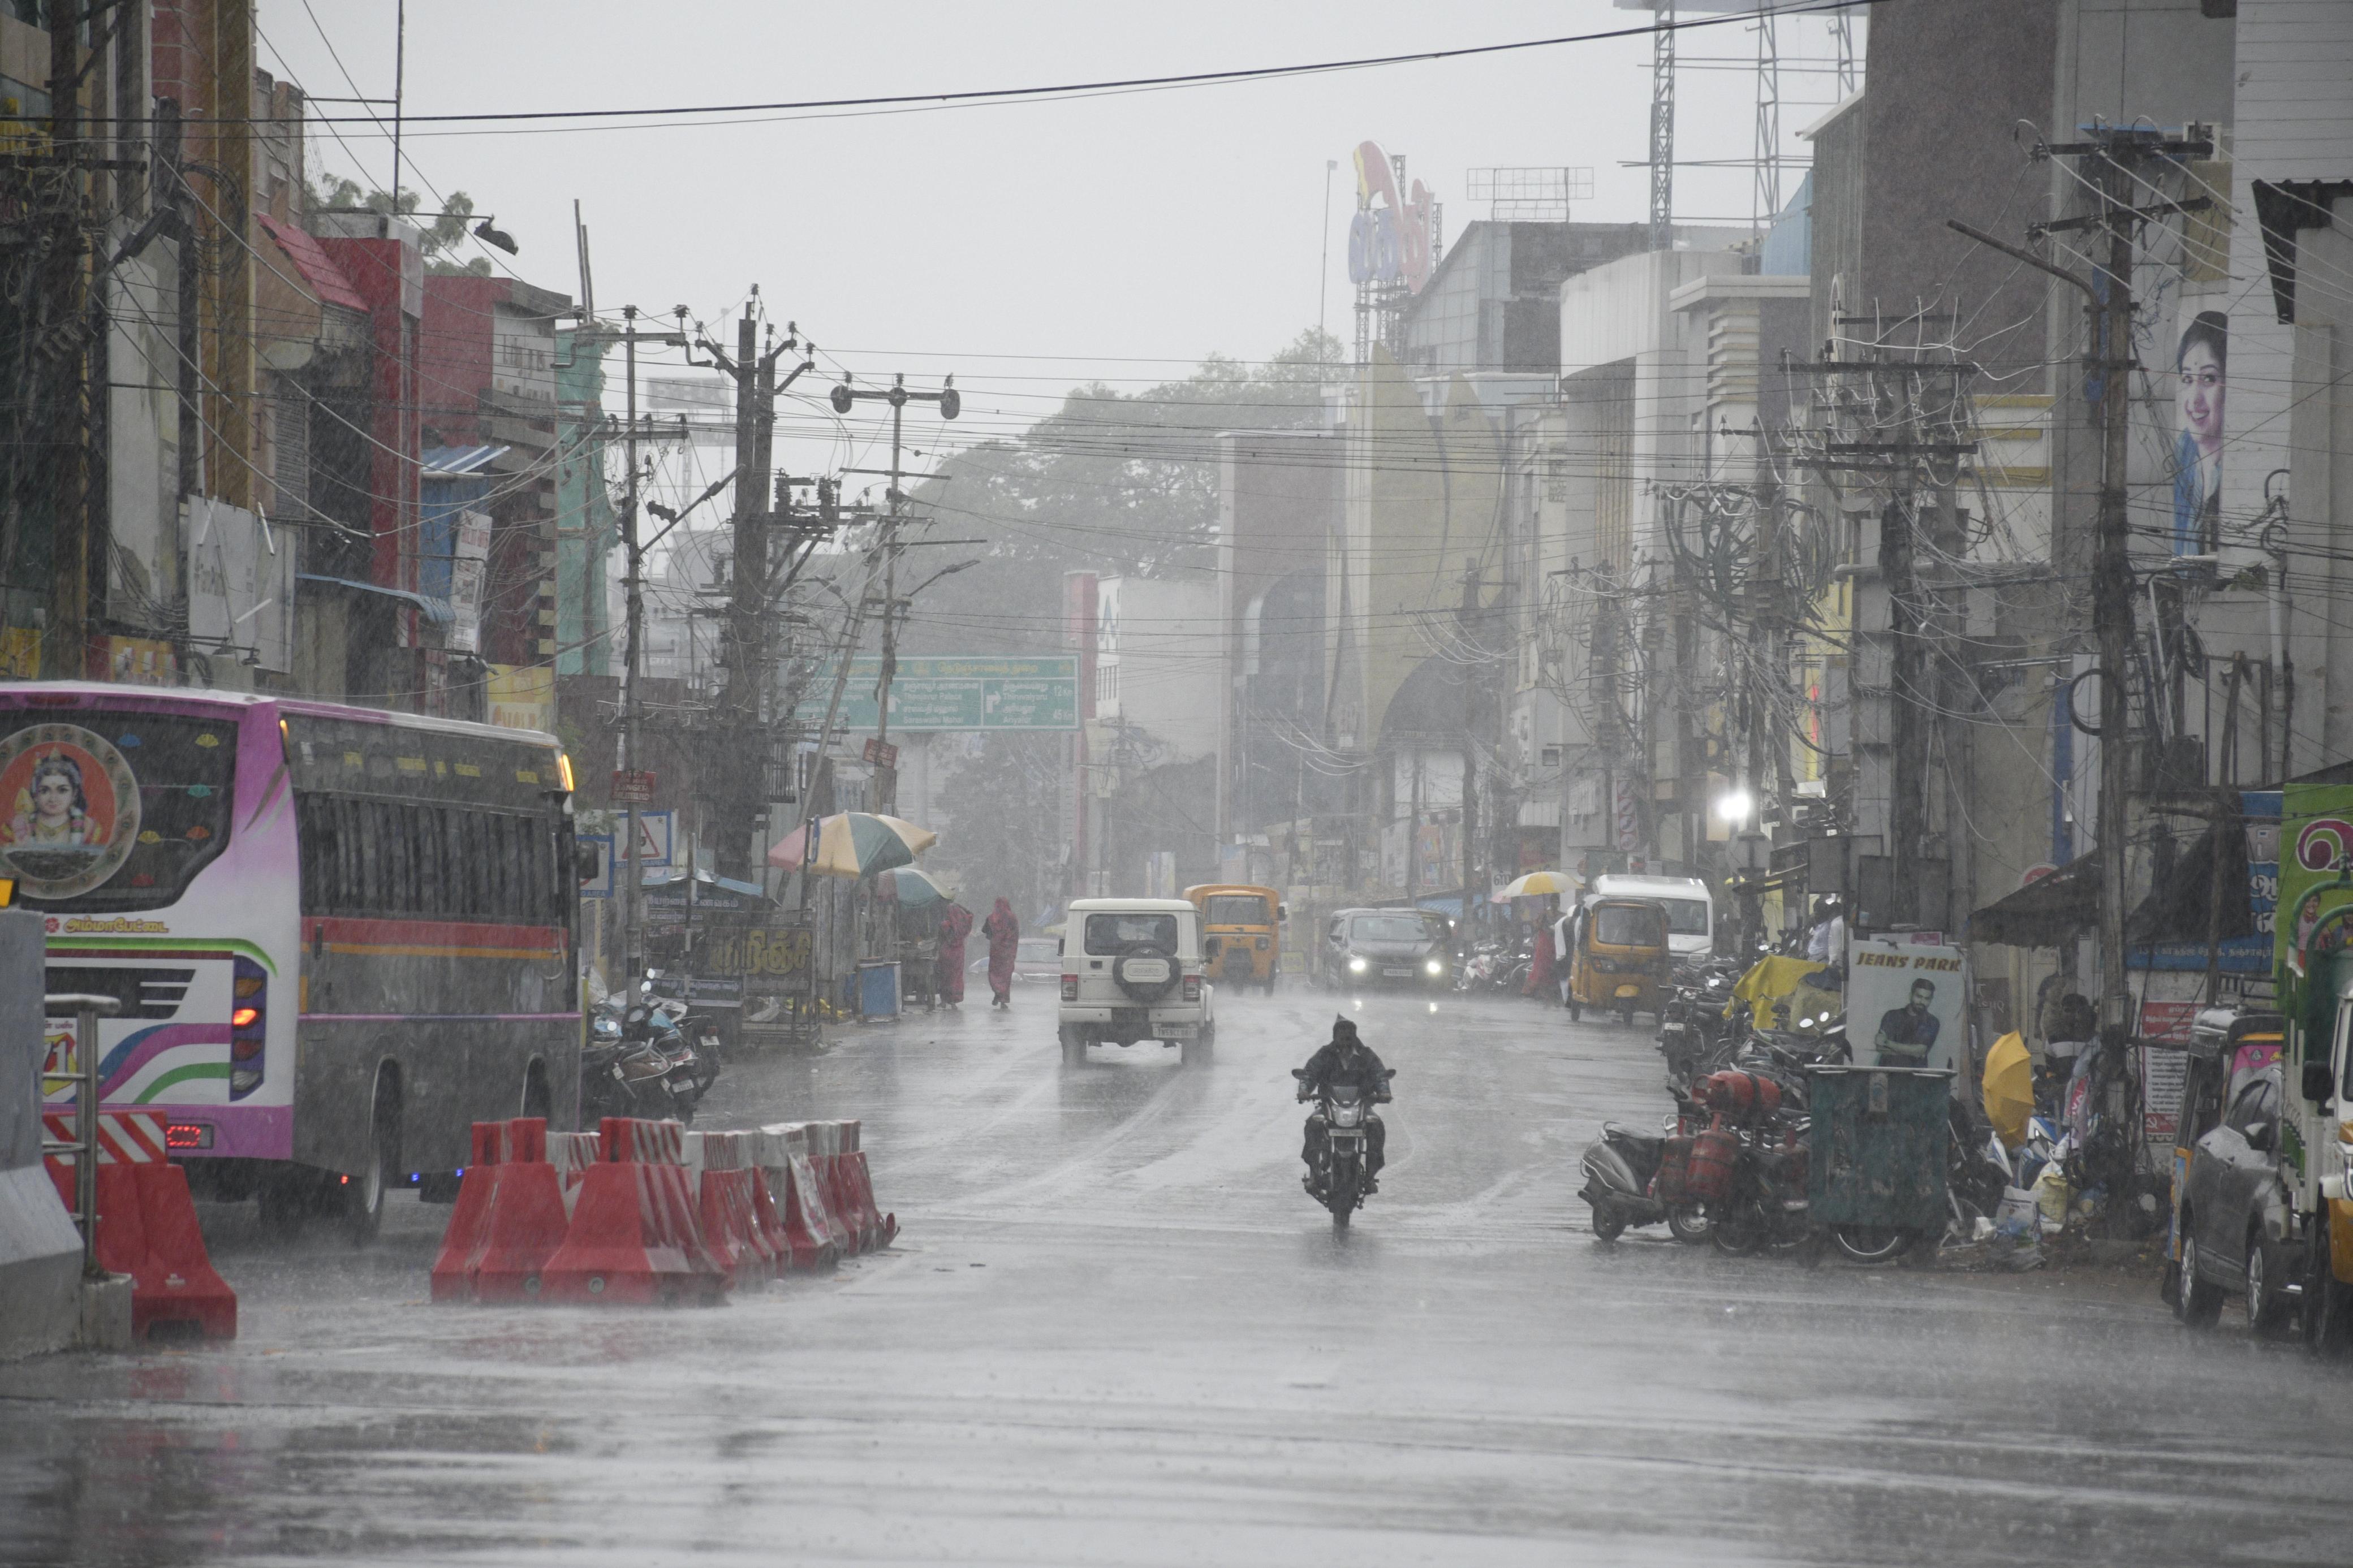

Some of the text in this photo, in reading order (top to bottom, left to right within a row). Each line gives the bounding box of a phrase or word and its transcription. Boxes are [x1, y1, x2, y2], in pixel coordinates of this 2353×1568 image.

[1053, 685, 1062, 697] 12
[64, 915, 169, 933] அம்மாபேட்டை
[1855, 952, 1962, 972] JEANS PARK
